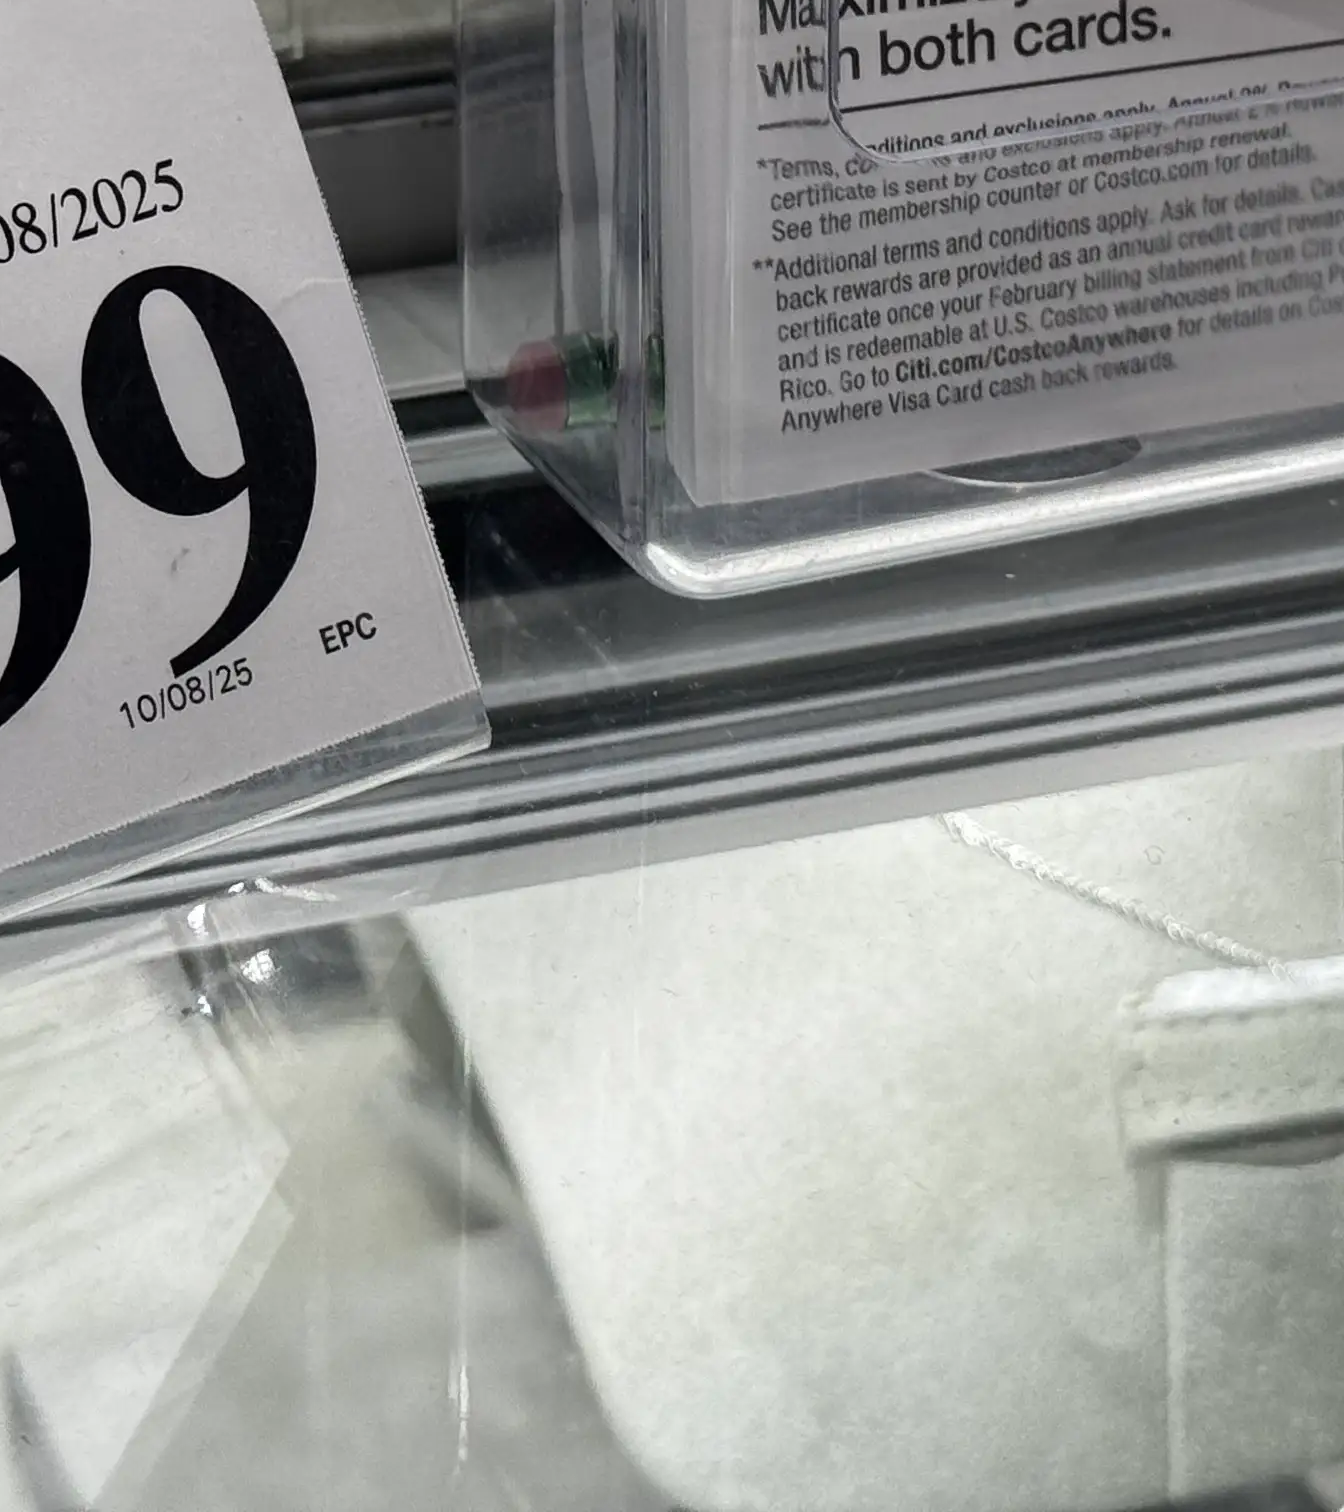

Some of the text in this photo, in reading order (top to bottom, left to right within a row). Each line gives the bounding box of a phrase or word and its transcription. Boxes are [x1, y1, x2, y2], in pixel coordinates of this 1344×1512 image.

[758, 0, 1172, 99] with both cards.
[771, 181, 877, 212] certificate
[883, 179, 900, 198] is
[905, 174, 949, 195] sent
[954, 172, 978, 189] by
[984, 160, 1053, 183] Costco
[1057, 154, 1076, 172] at
[1082, 137, 1204, 168] membership
[772, 154, 1242, 242] See the membership counter or Costco.com for
[883, 239, 940, 265] terms
[946, 227, 982, 256] and
[989, 216, 1091, 249] conditions
[1160, 197, 1196, 224] Ask
[1202, 194, 1228, 216] for
[776, 245, 1101, 312] back rewards are provided as an
[778, 306, 881, 343] certificate
[887, 301, 934, 326] once
[940, 293, 983, 322] your
[988, 278, 1077, 309] February
[778, 344, 819, 372] and
[825, 344, 841, 365] is
[847, 324, 963, 361] redeemable
[969, 318, 989, 342] at
[1041, 304, 1108, 331] Costco
[1113, 285, 1231, 318] warehouses
[840, 370, 865, 394] Go
[871, 365, 889, 388] to
[896, 323, 1172, 383] Citi.com/CostcoAnywhere
[781, 372, 1036, 435] Anywhere Visa Card cash
[318, 611, 378, 655] EPC
[119, 657, 254, 729] 10/08/25
